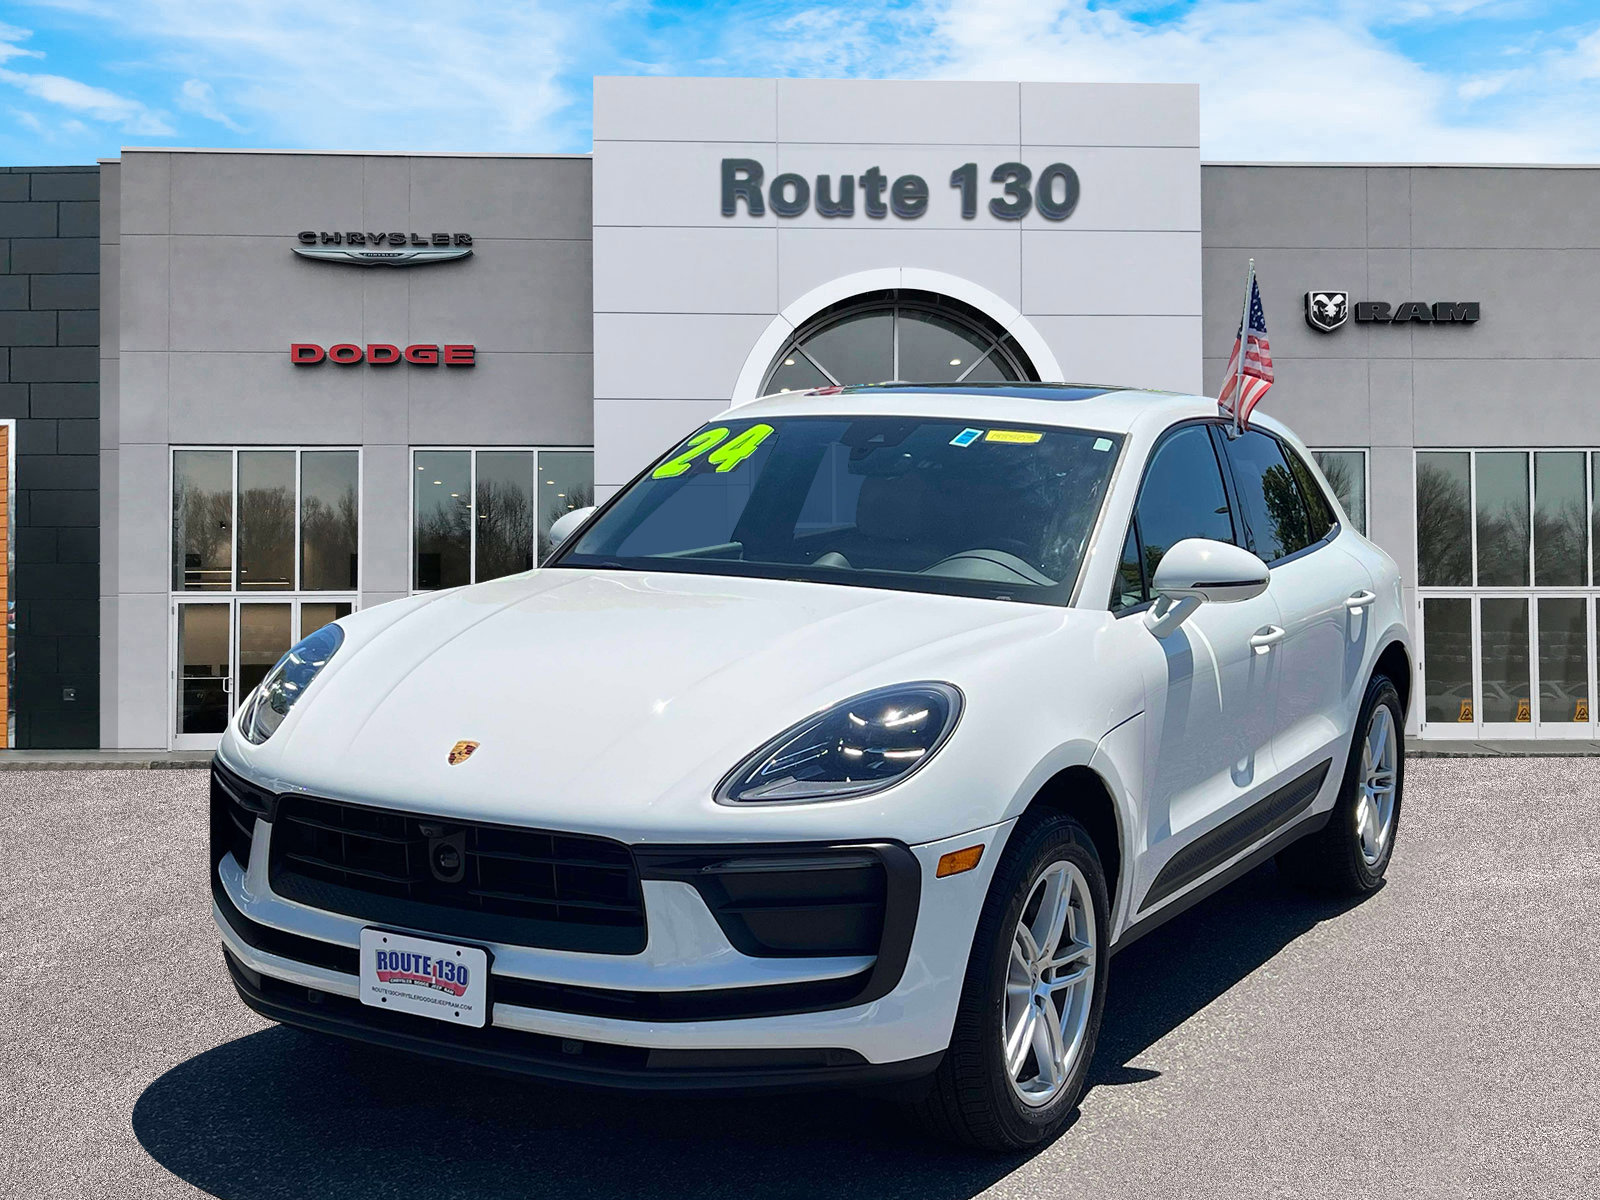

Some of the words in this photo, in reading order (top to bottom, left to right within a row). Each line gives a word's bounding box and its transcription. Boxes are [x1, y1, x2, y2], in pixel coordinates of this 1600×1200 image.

[720, 158, 930, 219] Route
[949, 161, 1081, 221] 130
[298, 231, 473, 245] CHRYSLER
[1355, 301, 1481, 324] RAM
[291, 343, 476, 365] DODGE
[652, 424, 775, 479] 24
[376, 951, 431, 976] ROUTE
[435, 960, 469, 986] 130
